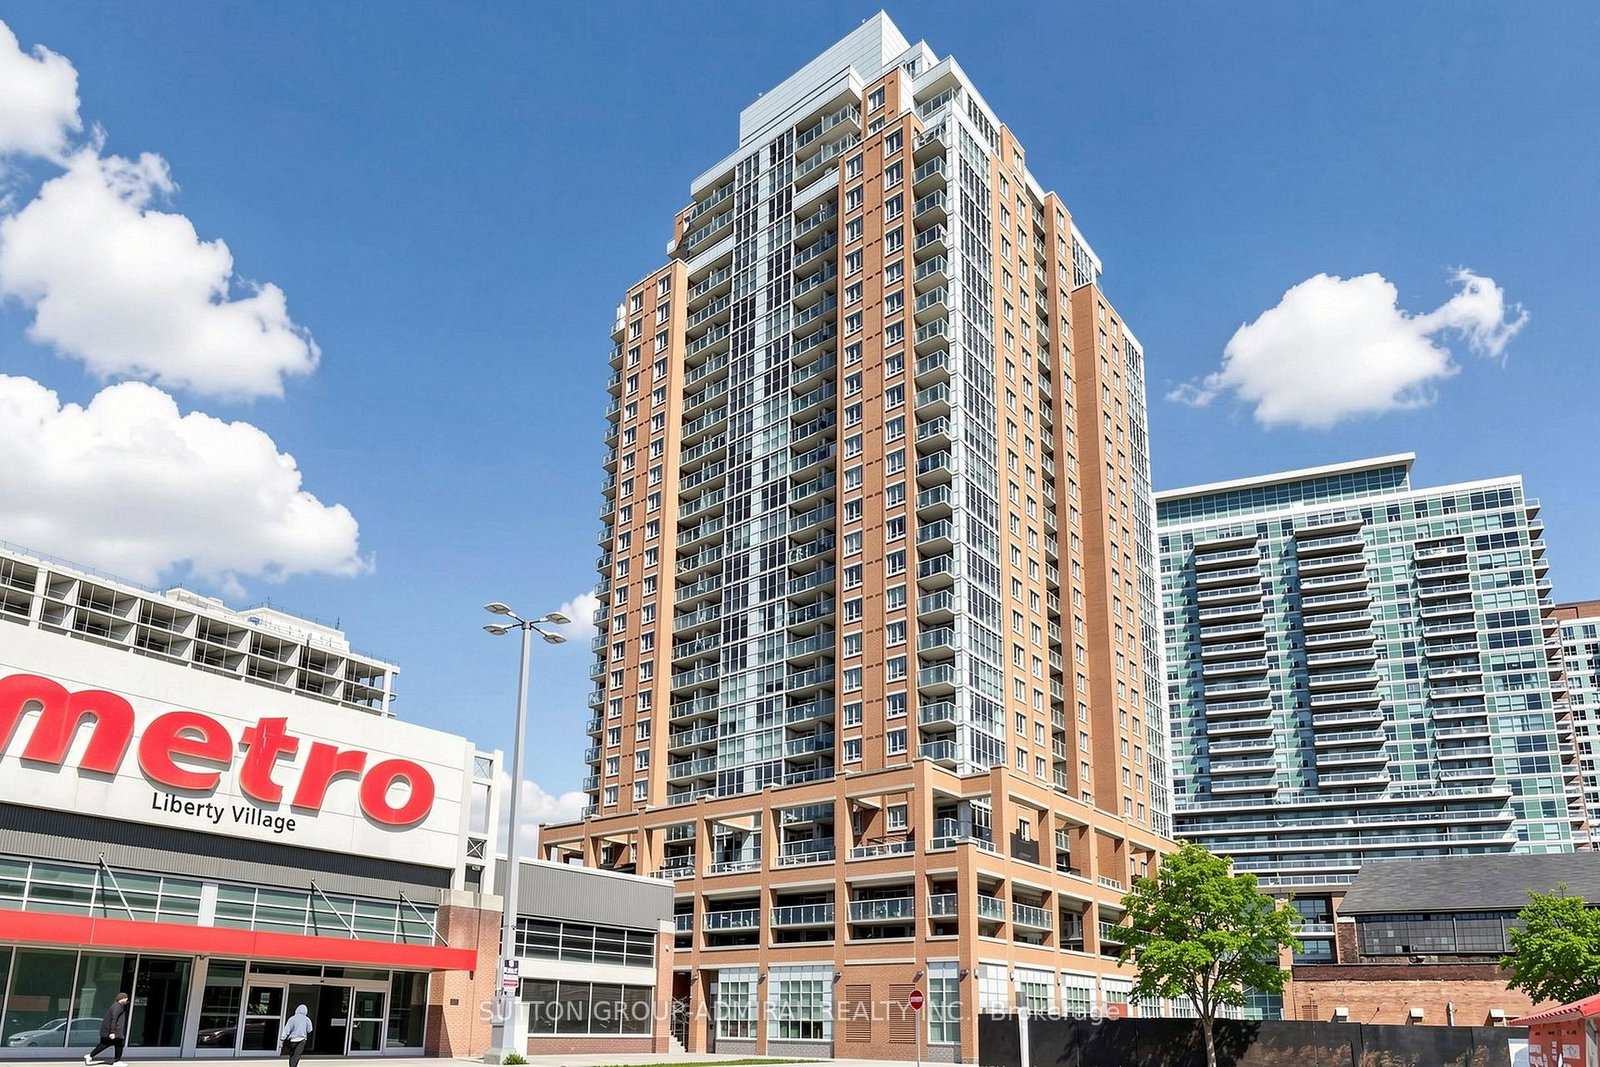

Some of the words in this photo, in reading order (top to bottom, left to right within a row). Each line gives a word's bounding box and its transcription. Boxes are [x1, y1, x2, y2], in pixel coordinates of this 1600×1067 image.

[0, 673, 435, 829] metro
[151, 791, 225, 825] Liberty
[232, 805, 297, 834] Village
